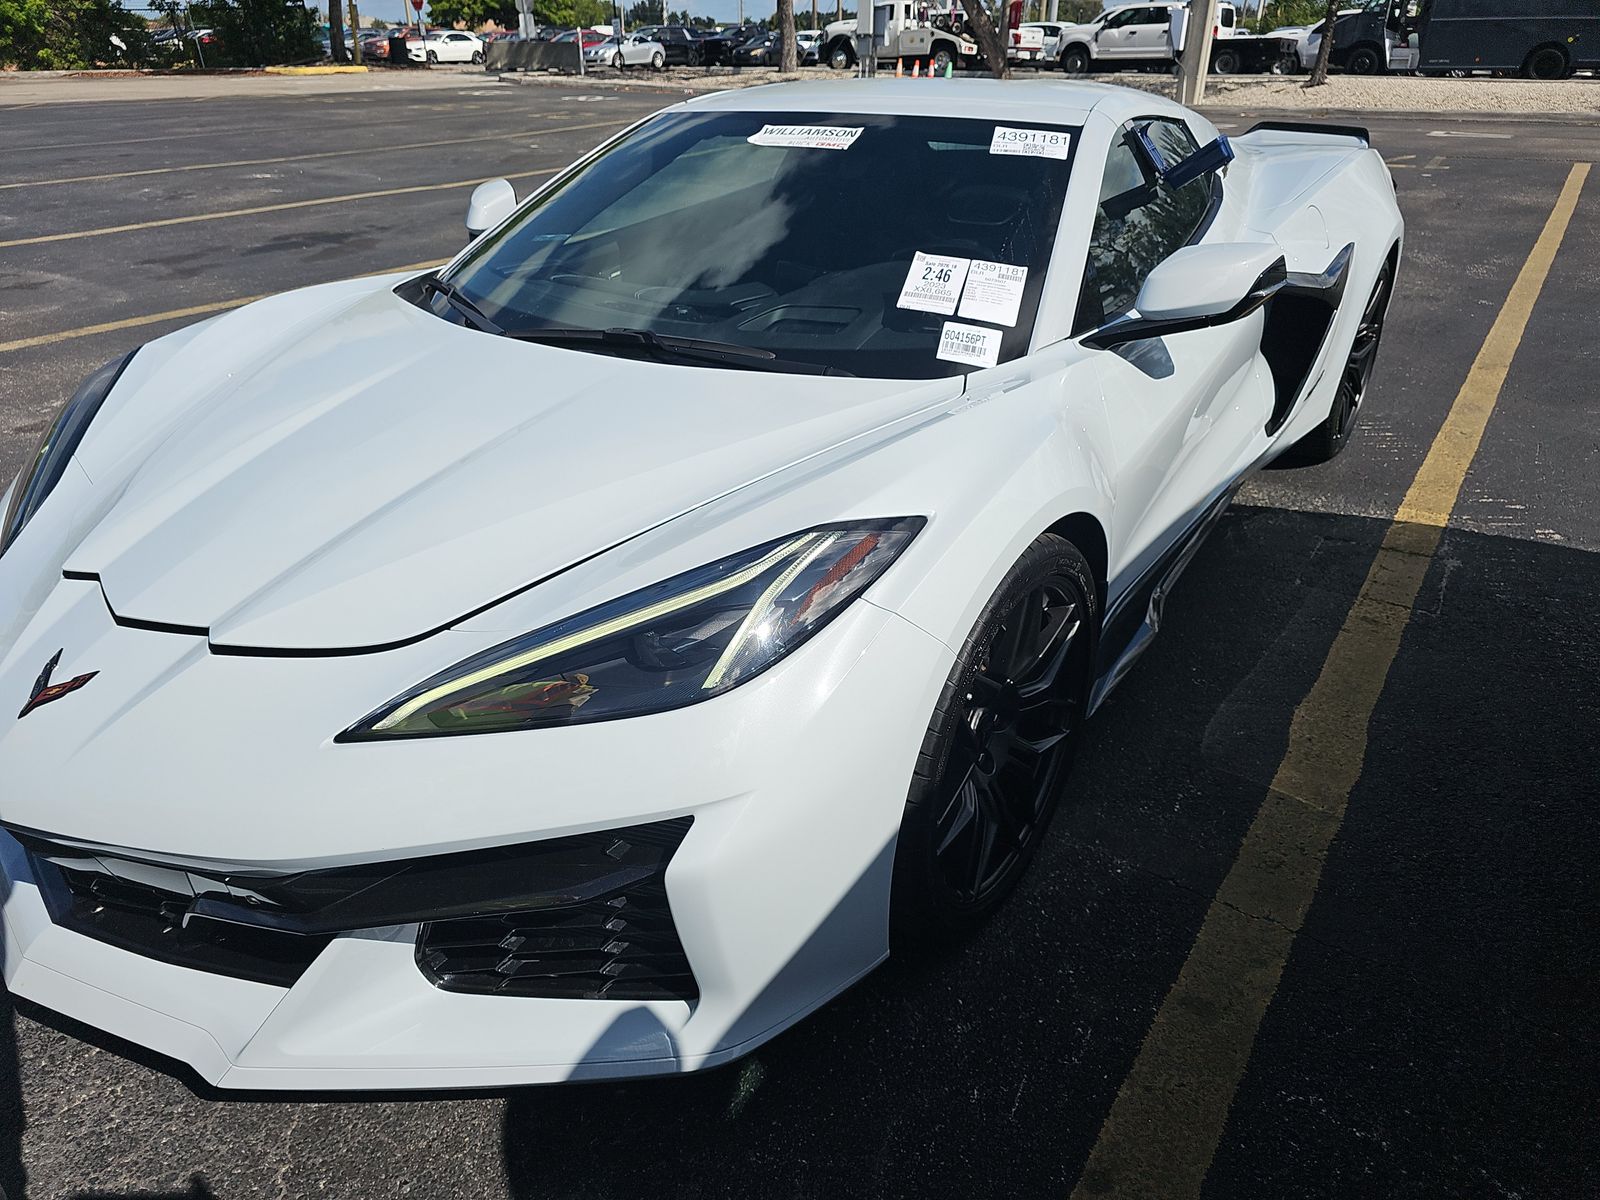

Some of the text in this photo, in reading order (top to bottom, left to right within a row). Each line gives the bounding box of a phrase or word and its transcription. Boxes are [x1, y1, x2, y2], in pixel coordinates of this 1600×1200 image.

[763, 127, 859, 138] WILLIAMSON
[997, 131, 1068, 146] 4391181
[922, 266, 953, 283] 2:46
[973, 262, 1025, 277] 4391181
[923, 281, 947, 289] 2023
[944, 329, 987, 347] 604156PT
